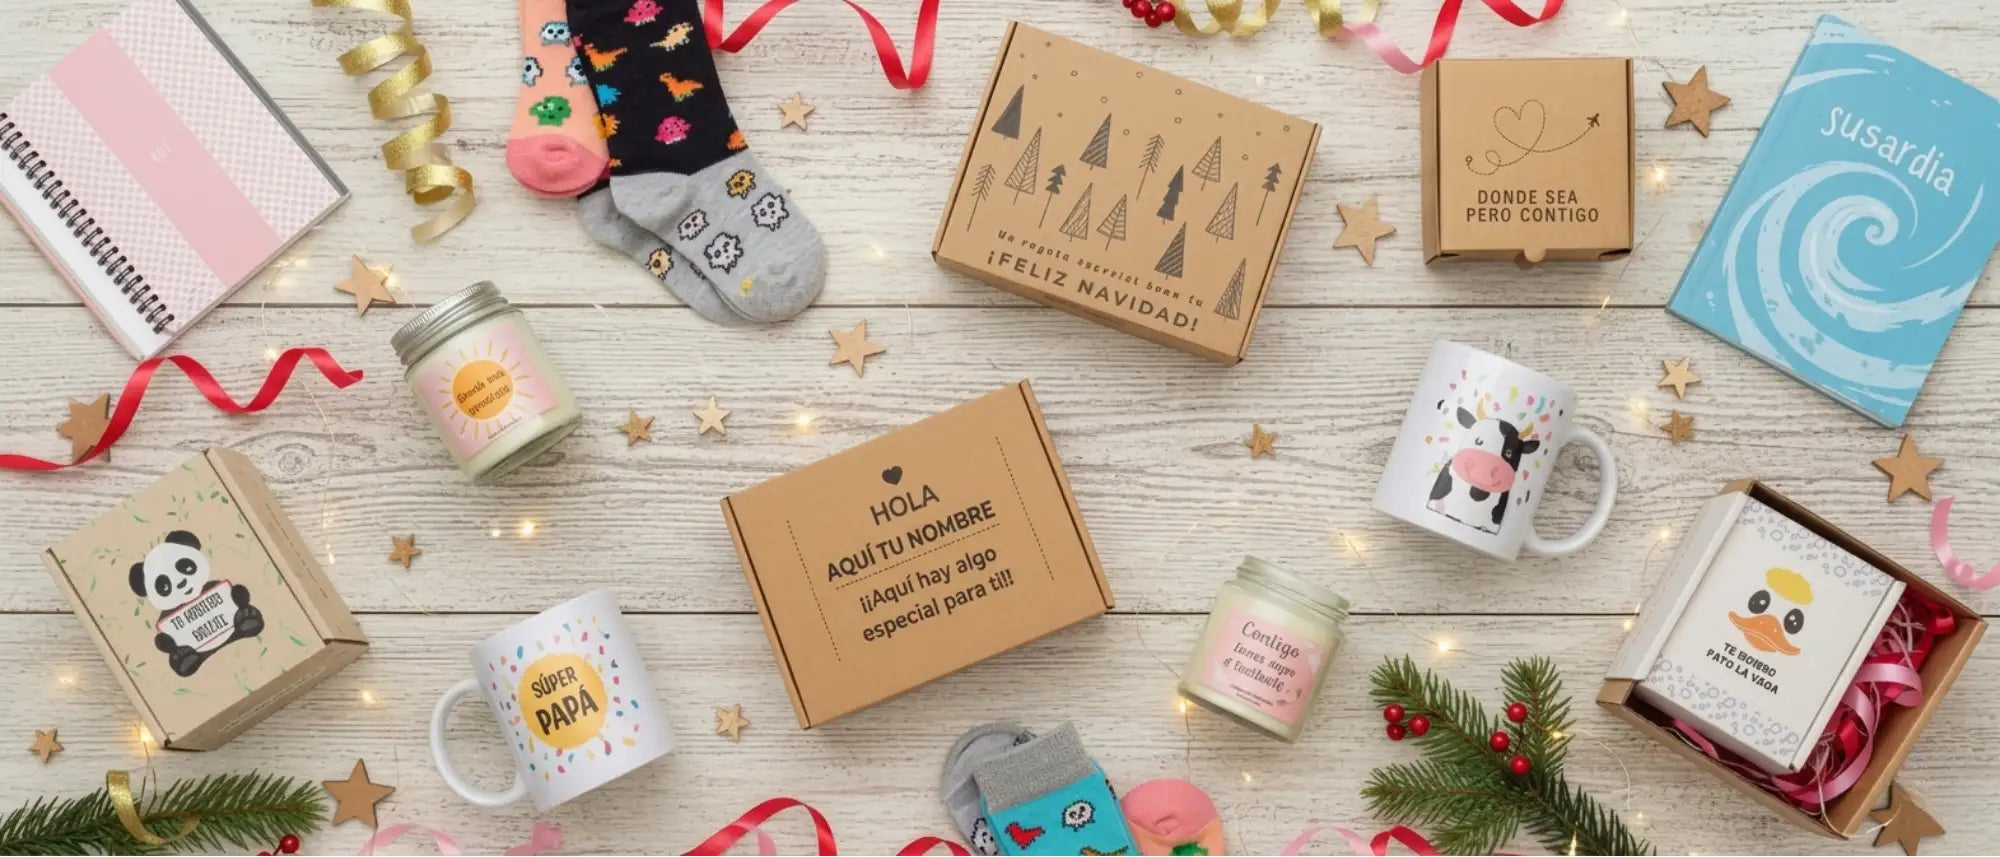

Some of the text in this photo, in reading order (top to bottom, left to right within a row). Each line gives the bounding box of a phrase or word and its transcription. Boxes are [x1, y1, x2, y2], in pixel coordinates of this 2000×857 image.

[1820, 106, 1955, 197] susardia
[1466, 208, 1599, 222] PERO CONTIGO
[1477, 190, 1578, 204] DONDE SEA
[987, 250, 1199, 332] ¡FELIZ NAVIDAD!
[870, 484, 940, 525] HOLA
[827, 500, 996, 582] AQUÍ TU NOMBRE
[915, 565, 951, 588] hay
[956, 548, 997, 574] algo
[863, 598, 940, 642] especial
[943, 583, 987, 614] para
[1706, 648, 1734, 669] PATO
[1735, 665, 1748, 679] LA
[1723, 642, 1737, 656] TE
[531, 666, 578, 698] SÚPER
[535, 684, 599, 736] PAPÁ
